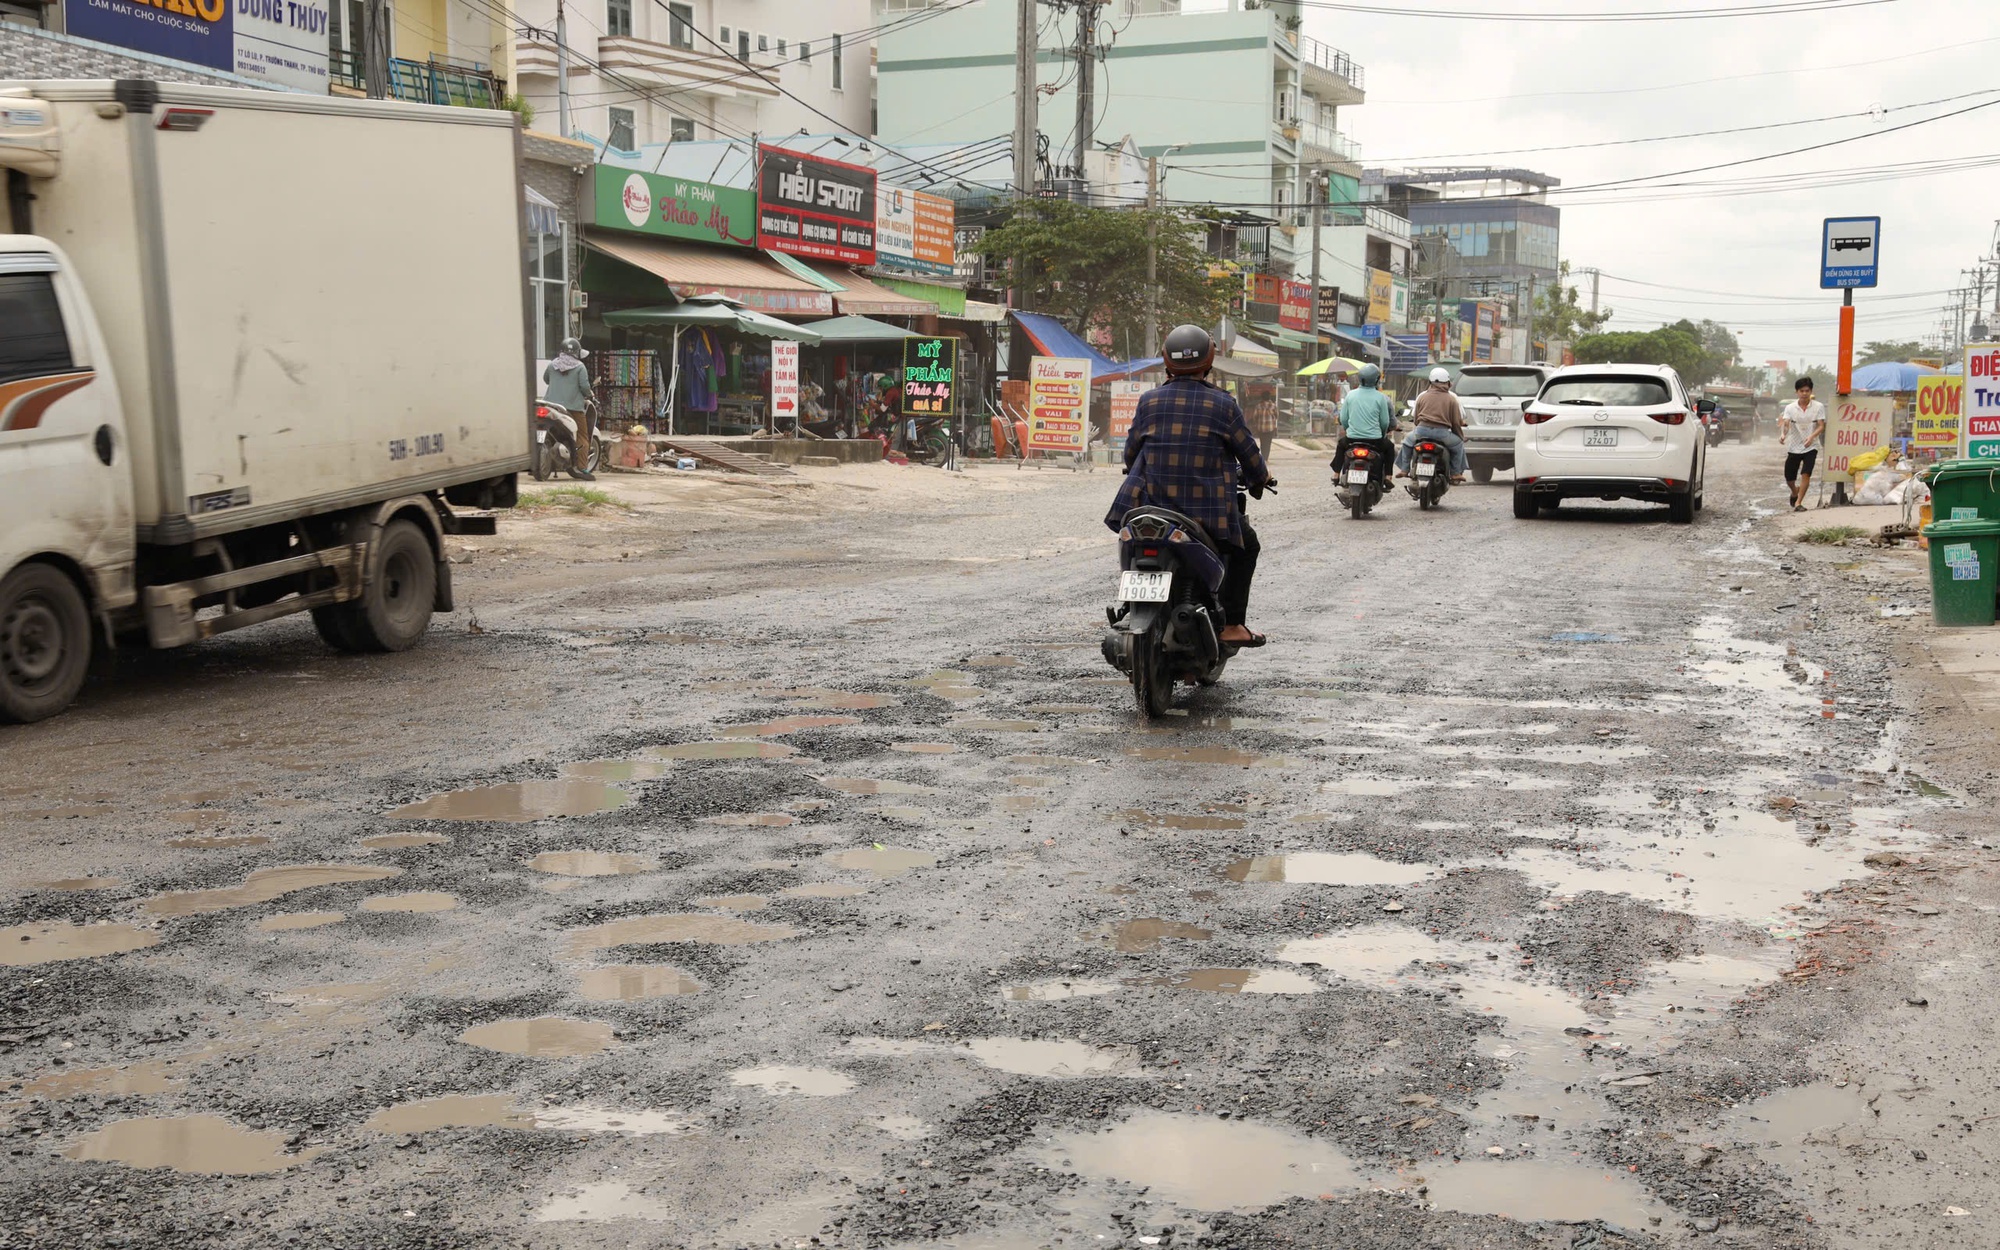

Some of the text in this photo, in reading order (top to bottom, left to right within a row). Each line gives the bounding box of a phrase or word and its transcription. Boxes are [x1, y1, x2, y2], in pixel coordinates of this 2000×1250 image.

[134, 9, 155, 21] CHO
[157, 14, 183, 29] CUỘC
[185, 20, 210, 35] SỐNG
[287, 2, 328, 36] THÚY
[816, 180, 864, 213] SPORT
[659, 196, 699, 226] Thảo
[1825, 268, 1837, 277] ĐIỂM
[1839, 268, 1852, 277] DỪNG
[1861, 268, 1874, 276] BUÝT
[775, 345, 784, 355] THẾ
[918, 340, 942, 358] MỸ
[906, 360, 952, 382] PHẨM
[1037, 362, 1060, 377] Hiếu
[906, 382, 950, 399] Thảo My
[1919, 380, 1962, 416] CƠM
[1837, 403, 1881, 422] Bán
[1114, 423, 1122, 432] XI
[1917, 419, 1934, 428] TRƯA
[1837, 425, 1877, 450] BẢO HỘ
[1828, 456, 1848, 471] LAO
[1130, 574, 1162, 585] 65-D1
[1124, 587, 1165, 600] 190.54
